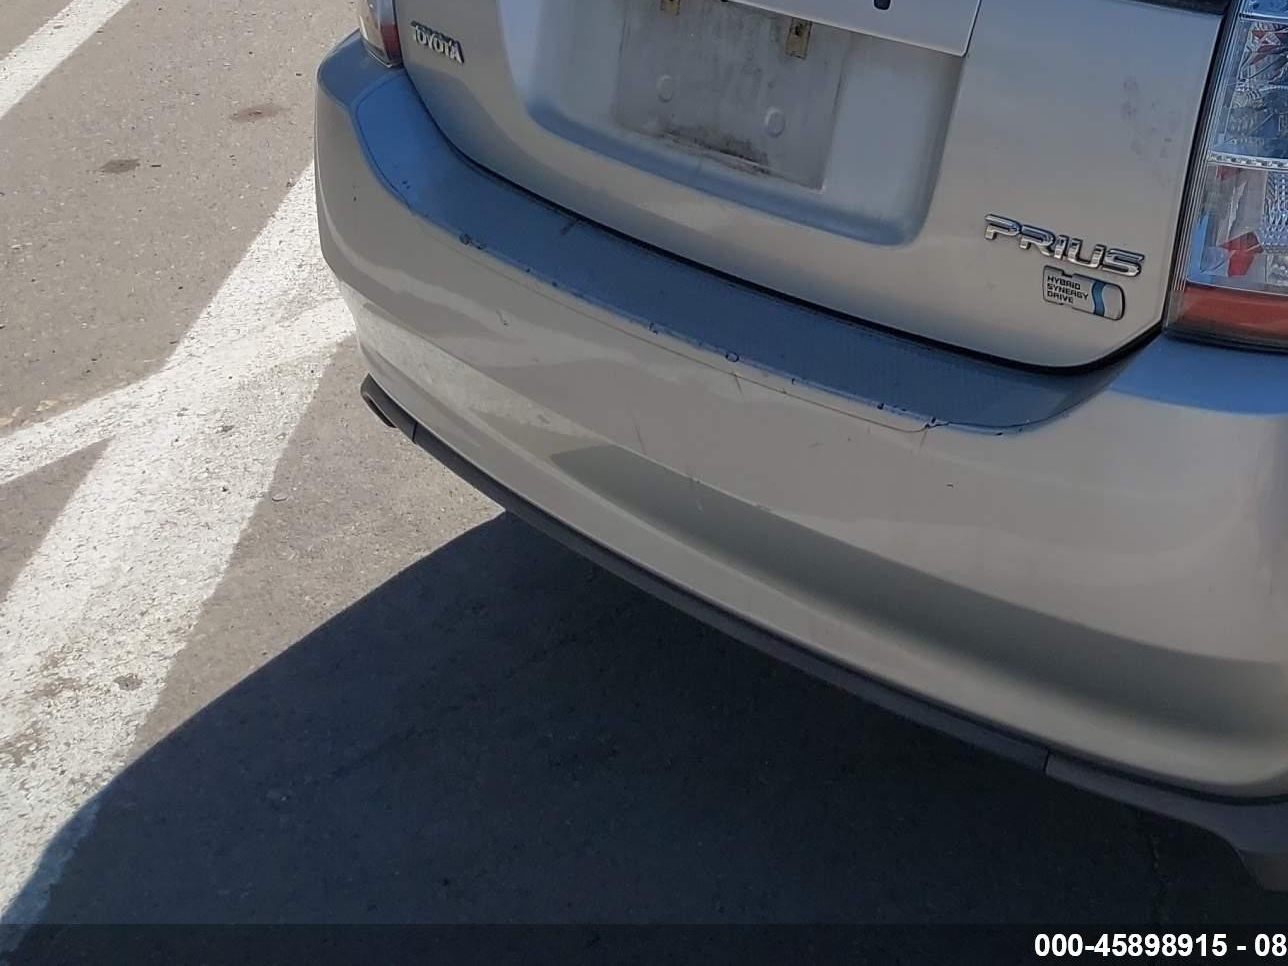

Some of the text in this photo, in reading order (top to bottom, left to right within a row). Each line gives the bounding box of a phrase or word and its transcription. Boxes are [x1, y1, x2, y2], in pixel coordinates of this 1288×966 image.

[411, 20, 464, 64] TOYOTA
[985, 213, 1145, 277] PRIUS
[1047, 275, 1081, 290] HYBRID
[1047, 282, 1089, 301] SYNERGY
[1047, 291, 1074, 304] DRIVE
